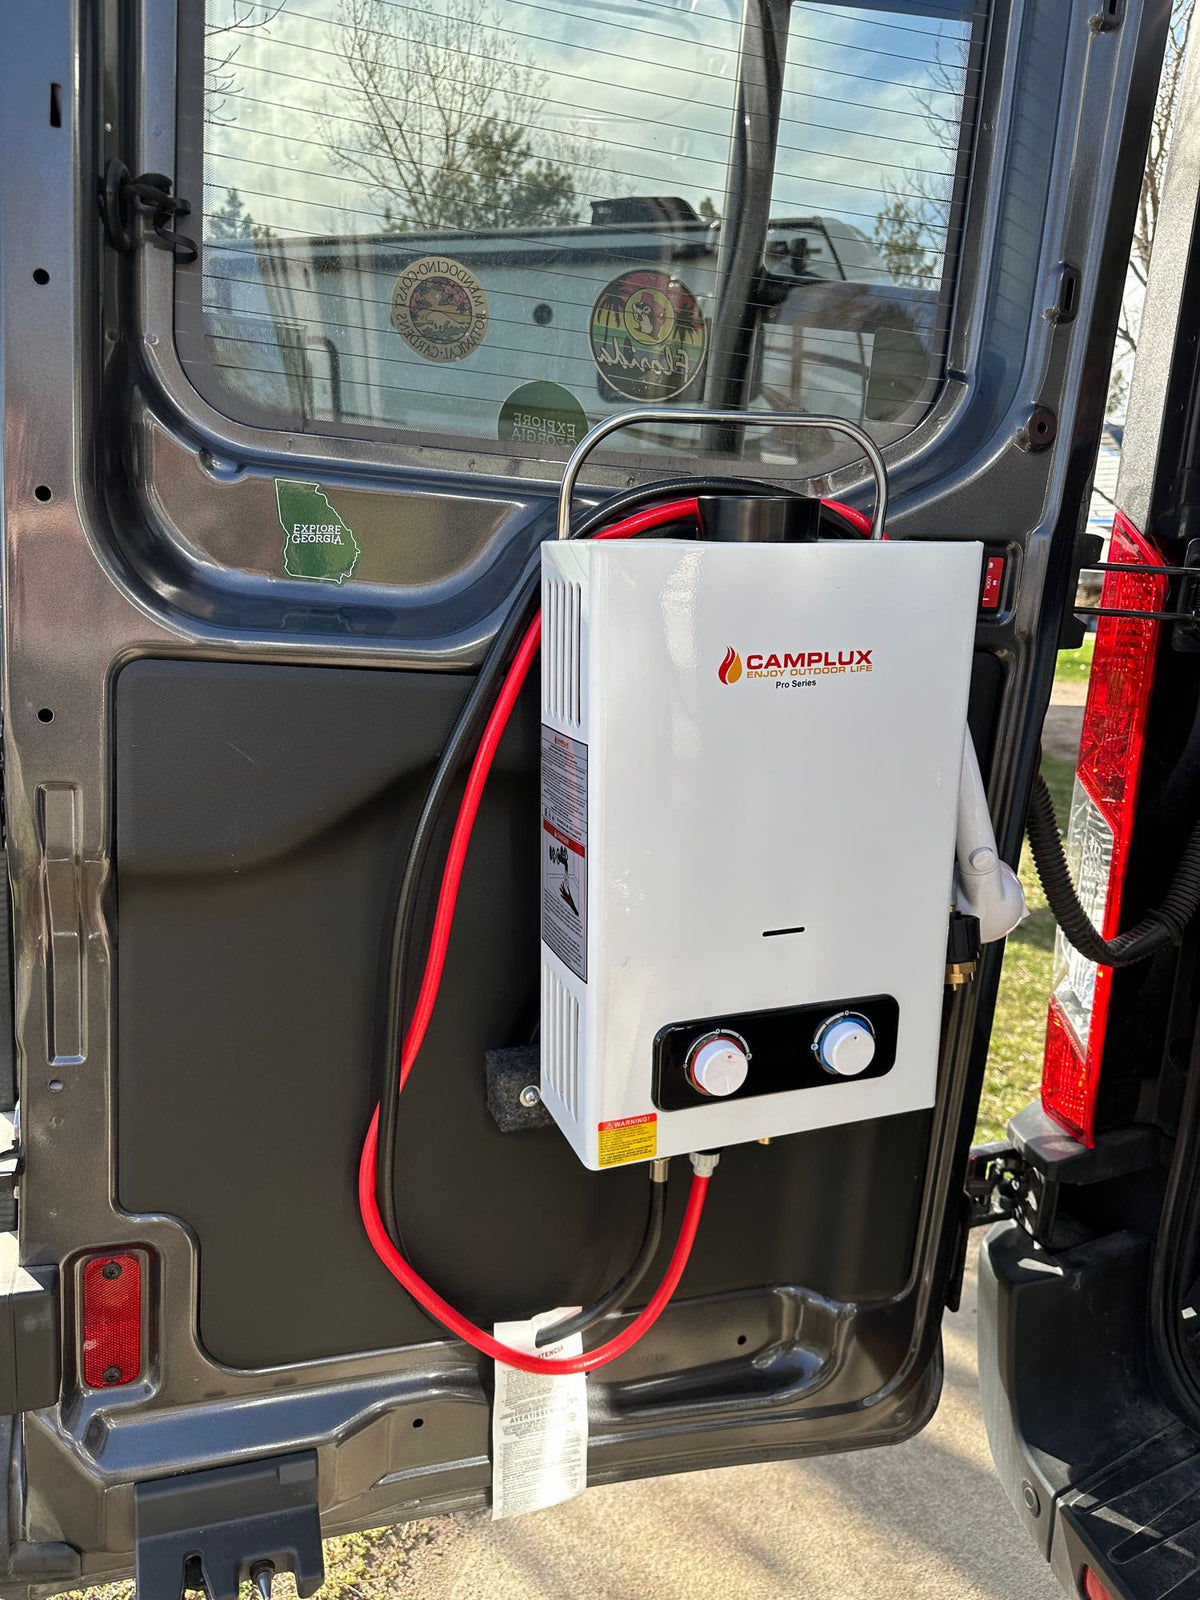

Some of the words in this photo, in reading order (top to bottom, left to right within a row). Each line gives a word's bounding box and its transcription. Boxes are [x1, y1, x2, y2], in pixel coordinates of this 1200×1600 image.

[293, 523, 342, 535] EXPLORE
[746, 649, 873, 670] CAMPLUX
[746, 669, 786, 679] ENJOY
[790, 666, 846, 676] OUTDOOR
[850, 664, 873, 673] LIFE
[775, 681, 790, 689] Pro
[791, 679, 817, 688] Series
[614, 1116, 650, 1128] WARNING!
[538, 1345, 564, 1360] TENCIA
